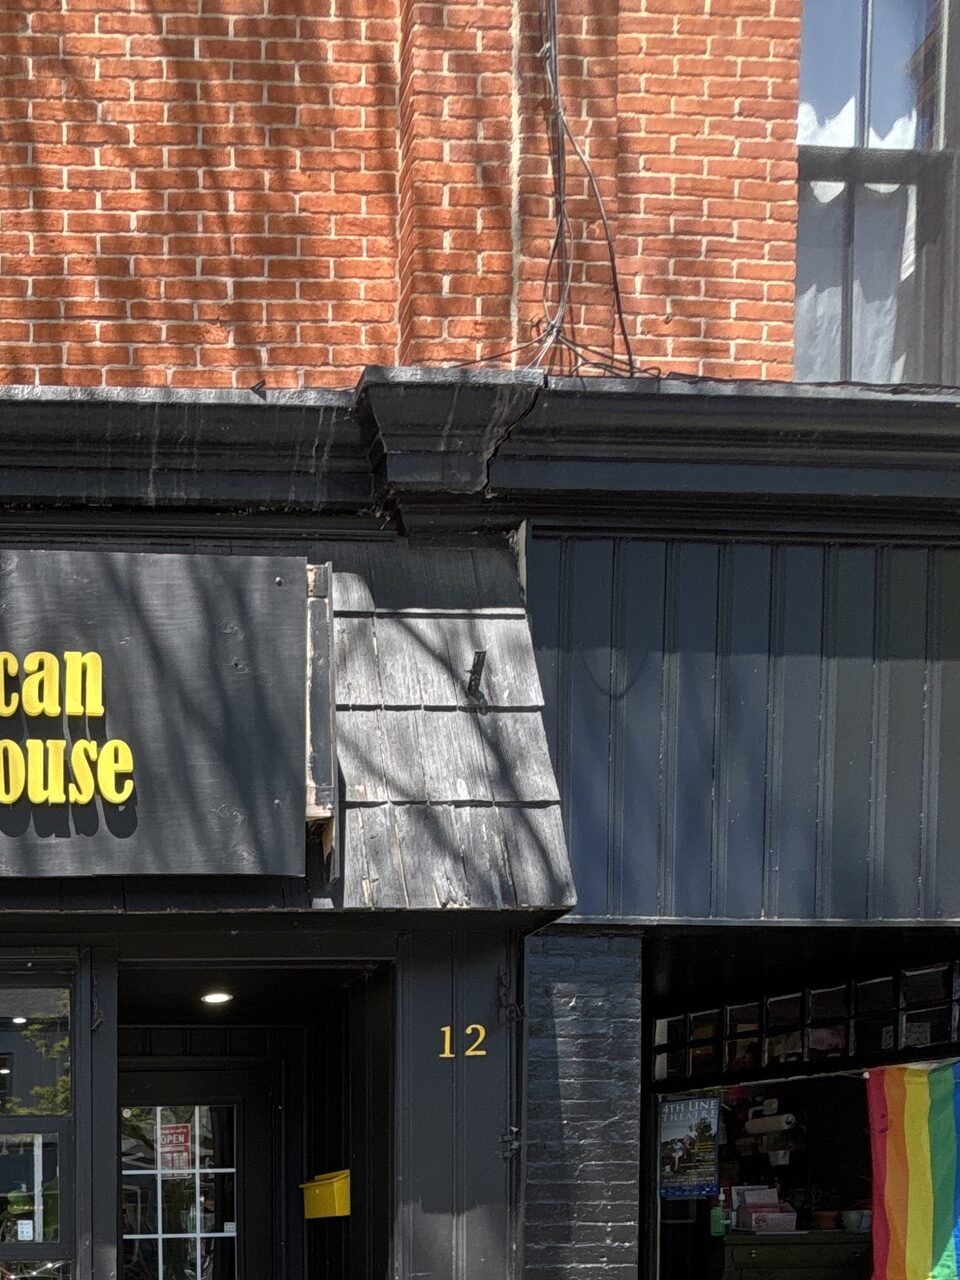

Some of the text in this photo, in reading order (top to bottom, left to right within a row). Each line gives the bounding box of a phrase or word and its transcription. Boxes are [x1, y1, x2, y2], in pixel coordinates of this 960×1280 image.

[439, 1023, 487, 1058] 12
[662, 1100, 718, 1114] 4TH LINE
[662, 1109, 718, 1121] THEATRE
[160, 1133, 185, 1145] OPEN
